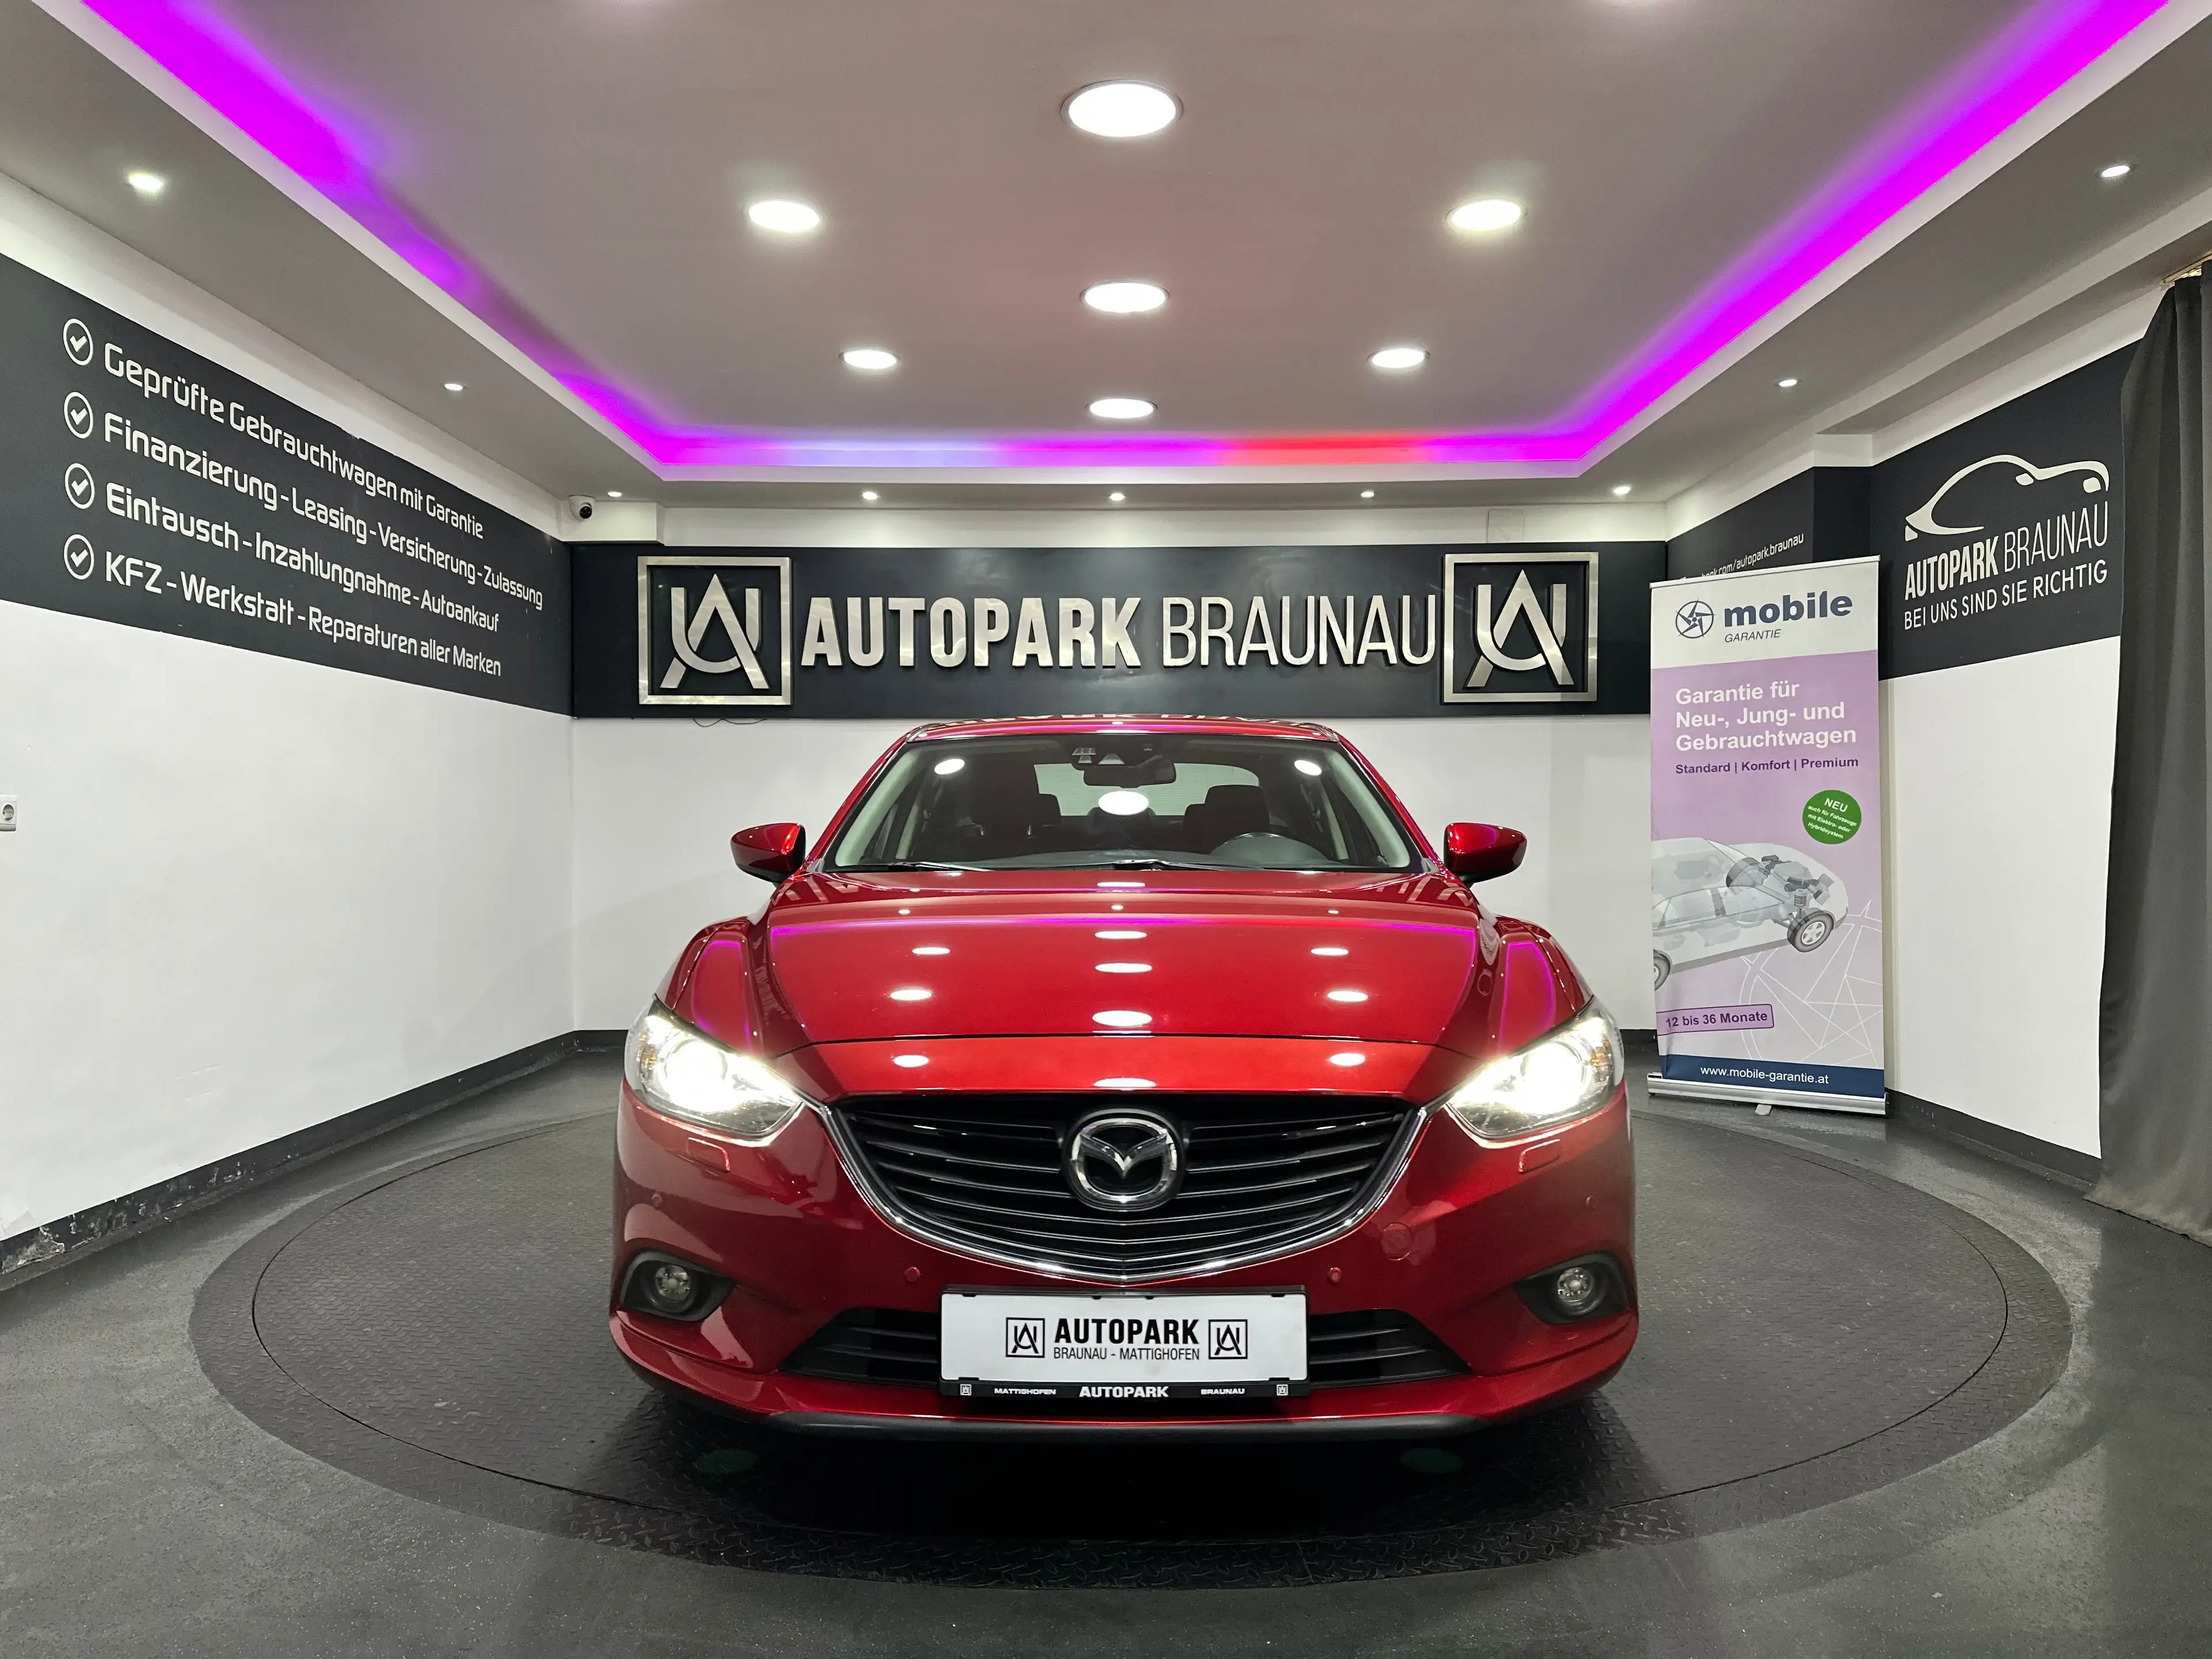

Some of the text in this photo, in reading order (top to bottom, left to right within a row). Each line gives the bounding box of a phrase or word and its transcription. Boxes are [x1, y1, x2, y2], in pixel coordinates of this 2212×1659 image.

[105, 342, 483, 539] Geprüfte Gebrauchtwagen mit Garantie
[105, 412, 277, 511] Finanzierung
[293, 487, 366, 544] Leasing
[378, 522, 475, 585] Versicherung
[484, 565, 543, 611] Zulassung
[106, 482, 238, 551] Eintausch
[256, 532, 411, 605] Inzahlungnahme
[421, 589, 499, 632] Autoankauf
[1904, 501, 2108, 600] AUTOPARK BRAUNAU
[1904, 559, 2108, 630] BEI UNS SIND SIE RICHTIG
[106, 551, 162, 594] KFZ
[180, 570, 294, 626] Werkstatt
[309, 605, 417, 656] Reparaturen
[421, 638, 450, 664] aller
[453, 645, 501, 677] Marken
[1725, 590, 1853, 627] mobile
[801, 596, 1141, 667] AUTOPARK
[1162, 594, 1436, 667] BRAUNAU
[1725, 628, 1782, 643] GARANTIE
[1676, 680, 1800, 704] Garantie für
[1676, 701, 1844, 729] Neu-, Jung- und
[1676, 729, 1857, 751] Gebrauchtwagen
[1676, 762, 1730, 774] Standard
[1741, 760, 1790, 772] Komfort
[1801, 757, 1859, 769] Premium
[1808, 805, 1821, 813] auch
[1830, 813, 1857, 827] Fahrzeuge
[1824, 797, 1849, 812] NEU
[1808, 821, 1844, 839] Hybridsystem
[1666, 1011, 1768, 1028] 12 bis 36 Monate
[1700, 1066, 1830, 1085] www.mobile-garantie.at
[1054, 1318, 1200, 1344] AUTOPARK
[1054, 1347, 1107, 1359] BRAUNAU
[1120, 1347, 1200, 1360] MATTIGHOFEN
[1079, 1385, 1169, 1398] AUTOPARK
